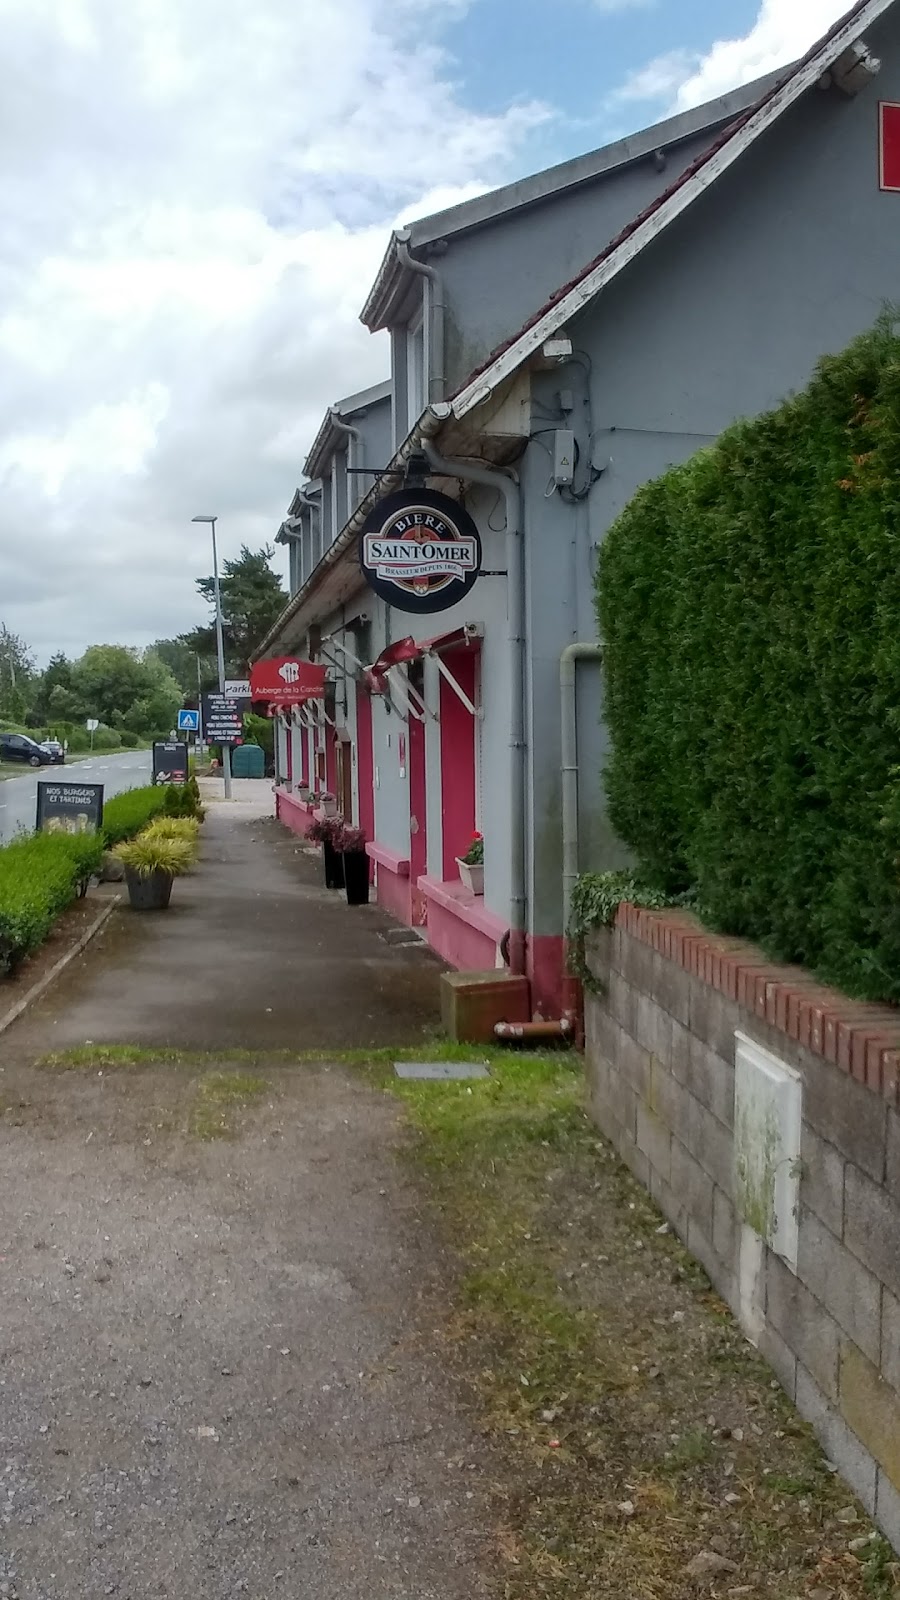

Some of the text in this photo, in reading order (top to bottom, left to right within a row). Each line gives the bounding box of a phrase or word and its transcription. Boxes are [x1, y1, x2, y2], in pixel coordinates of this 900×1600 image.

[394, 513, 446, 534] BIERE
[420, 563, 443, 573] DEPUIS
[255, 687, 282, 695] Auberge
[46, 787, 96, 797] NOS BURGERS
